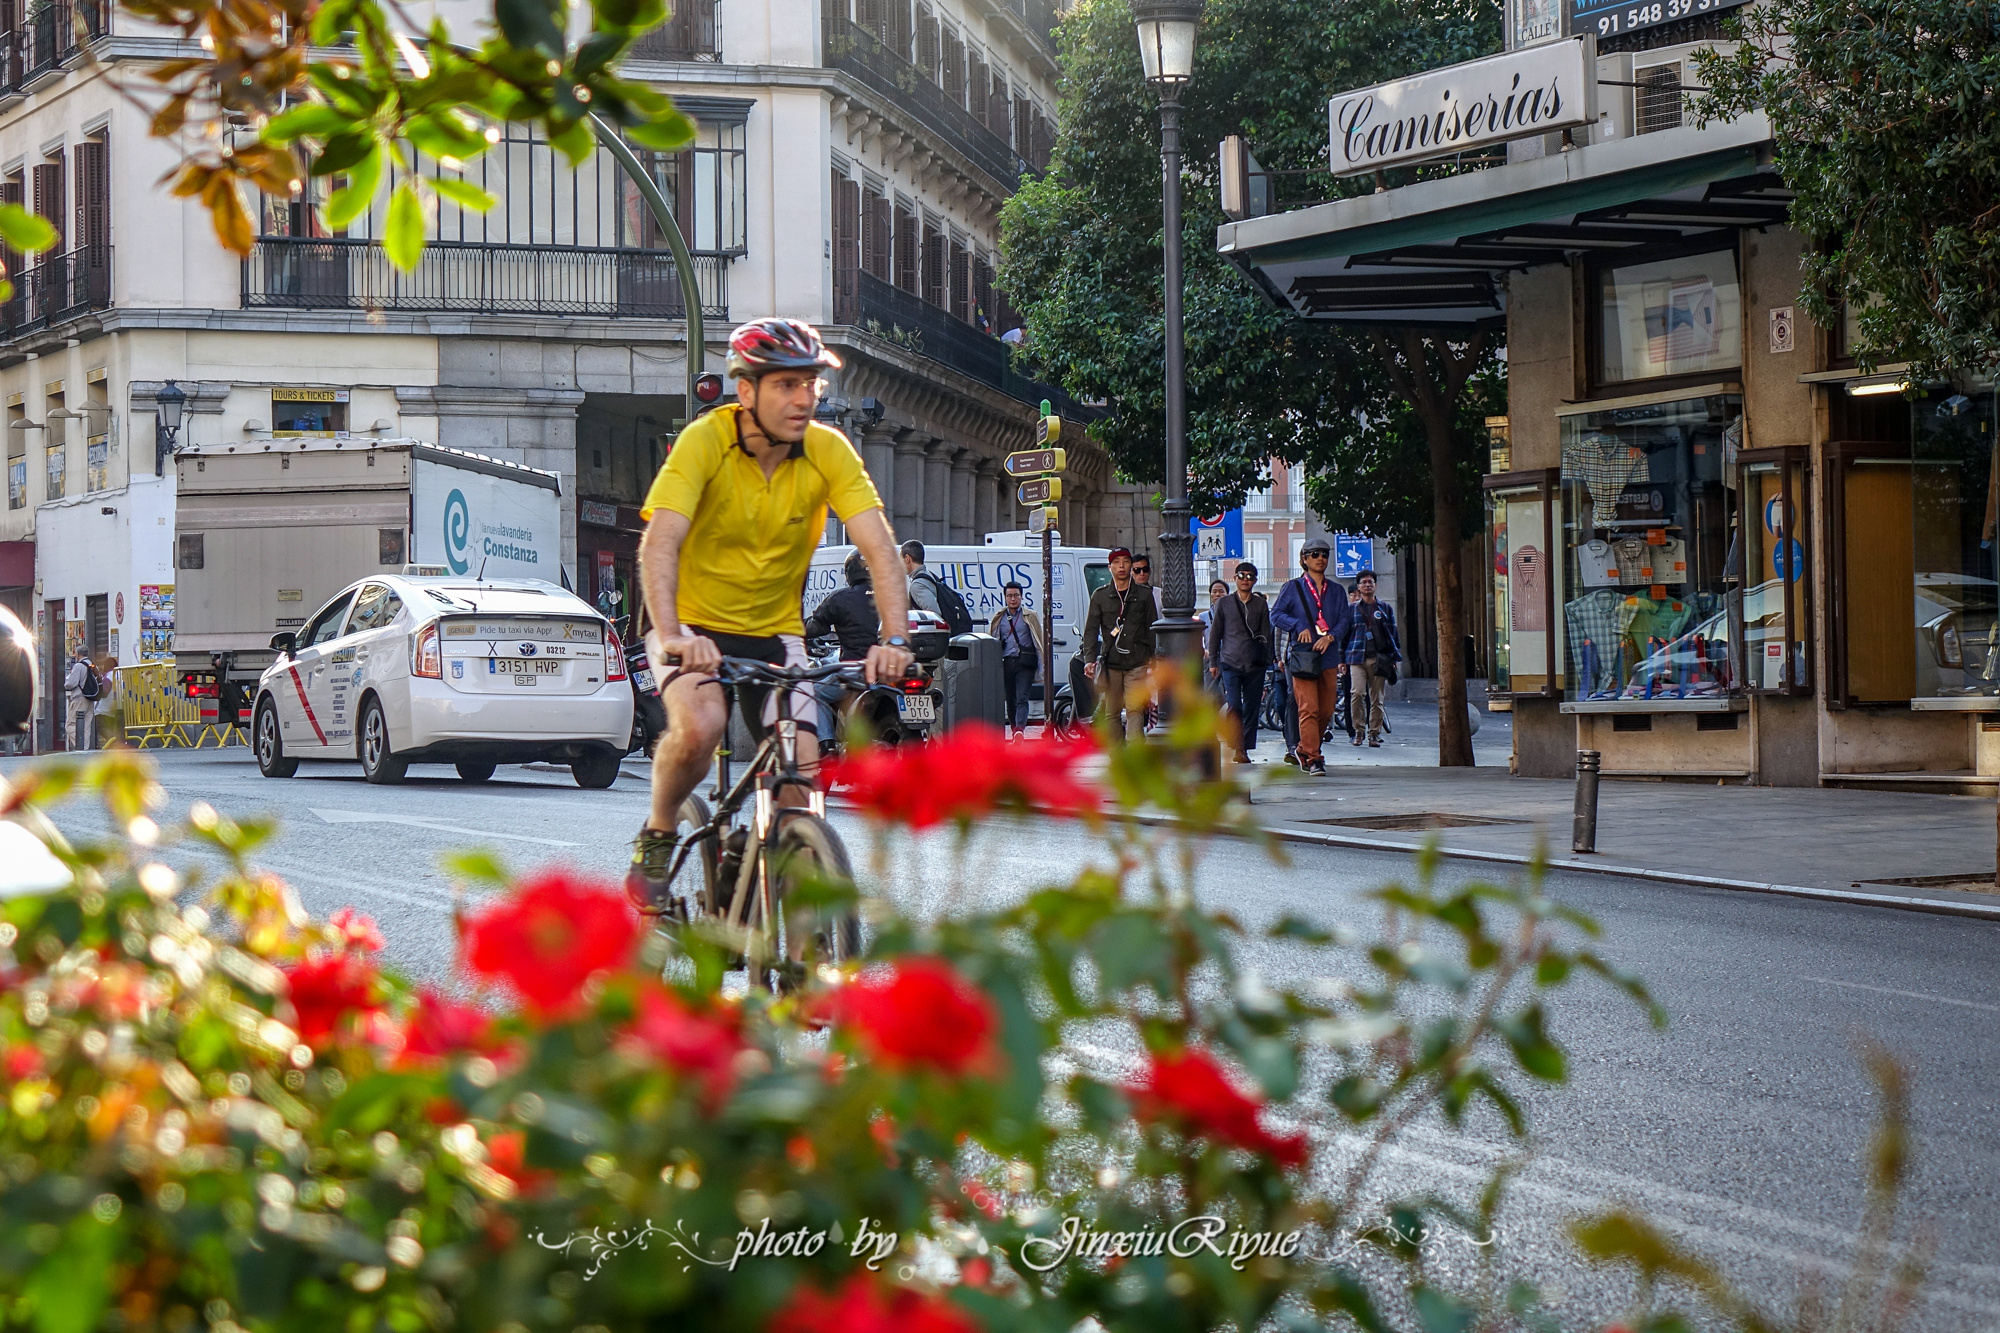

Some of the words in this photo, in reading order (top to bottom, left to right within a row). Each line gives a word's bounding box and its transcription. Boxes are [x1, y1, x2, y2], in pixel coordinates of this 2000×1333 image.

[1598, 14, 1618, 34] 91
[1628, 4, 1662, 28] 548
[1668, 0, 1692, 17] 39
[1522, 22, 1552, 42] CALLE
[274, 390, 298, 400] TOURS
[300, 391, 304, 400] &
[306, 390, 334, 400] TICKETS
[484, 537, 538, 564] Constanza
[807, 570, 837, 590] ELOS
[940, 563, 1033, 590] HIELOS
[980, 592, 1034, 608] ANS
[536, 627, 552, 636] App!
[573, 630, 597, 638] mytaxi
[488, 642, 498, 656] X
[546, 646, 566, 654] 03212
[499, 661, 528, 673] 3151
[536, 661, 558, 673] HVP
[906, 697, 929, 707] 8767
[910, 708, 929, 718] DTG
